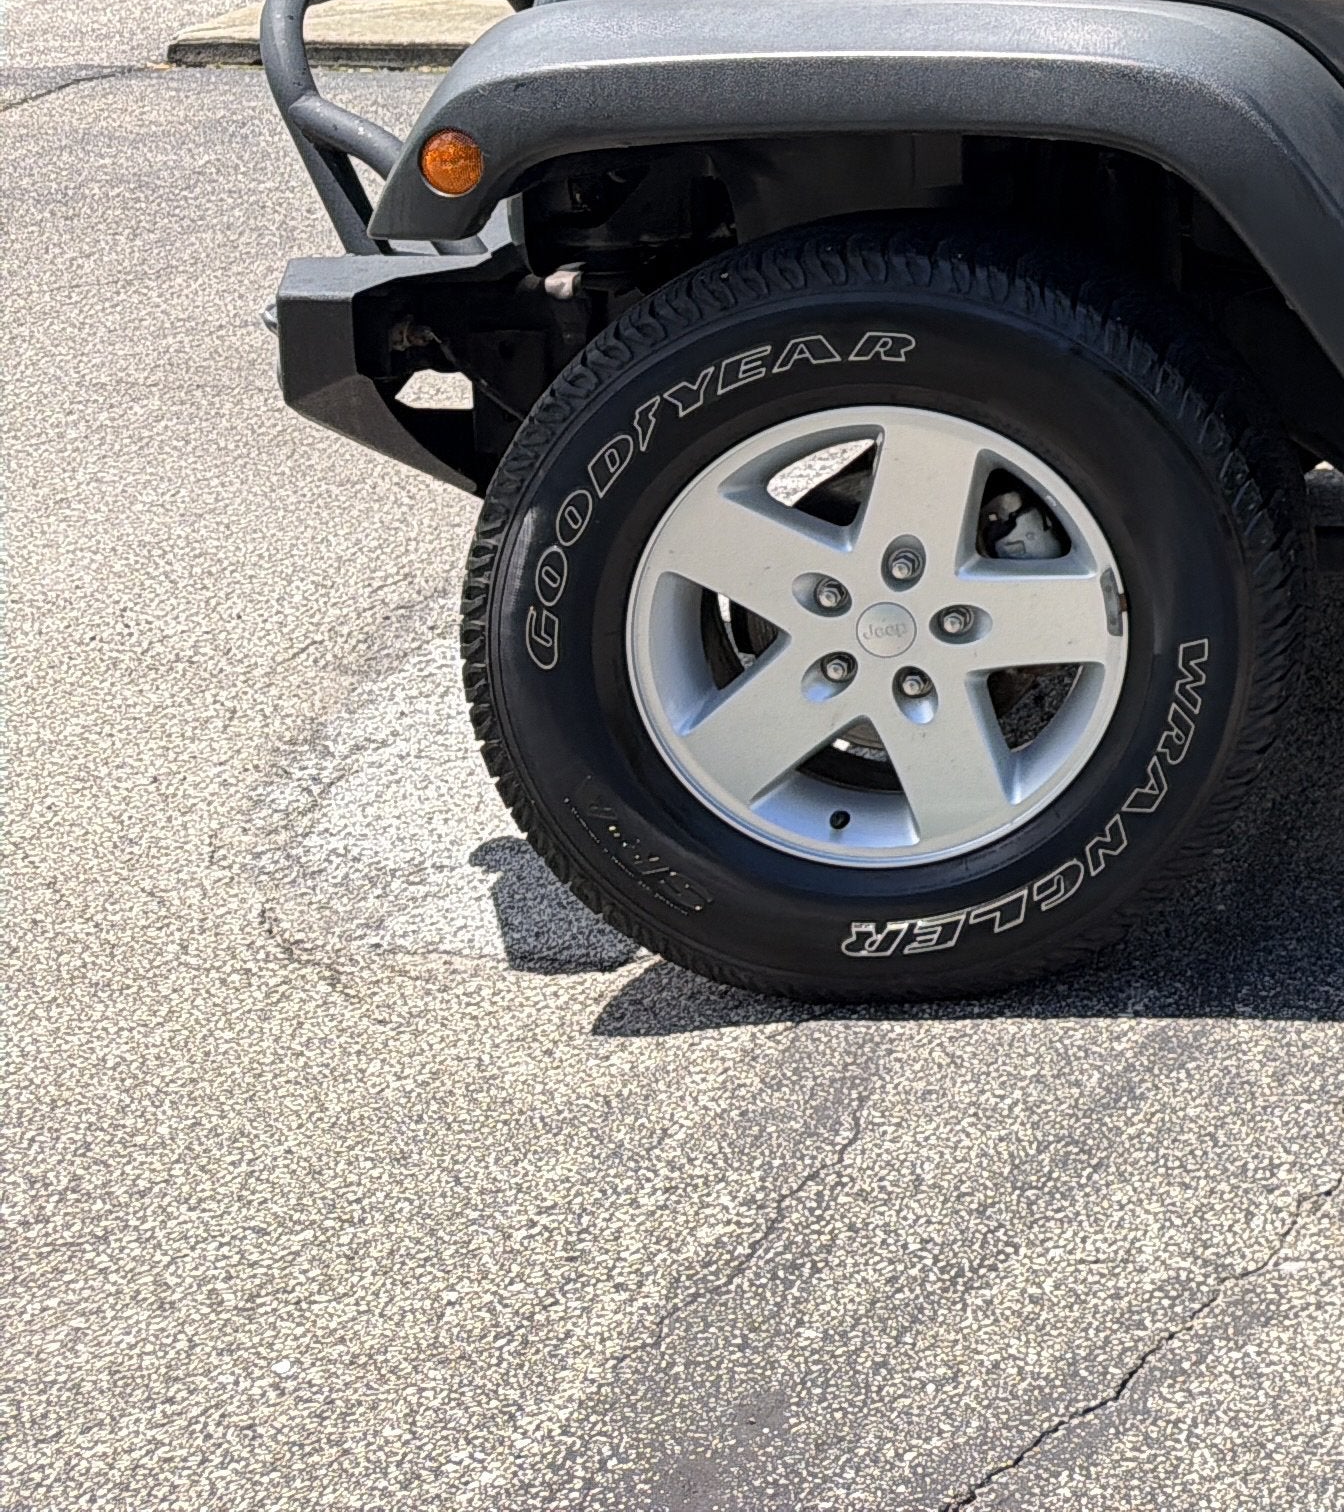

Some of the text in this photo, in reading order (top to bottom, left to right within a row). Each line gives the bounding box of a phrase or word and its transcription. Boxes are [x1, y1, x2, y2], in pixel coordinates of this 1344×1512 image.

[526, 331, 916, 670] GOODYEAR
[862, 622, 908, 640] Jeep
[841, 638, 1209, 959] WRANGLER
